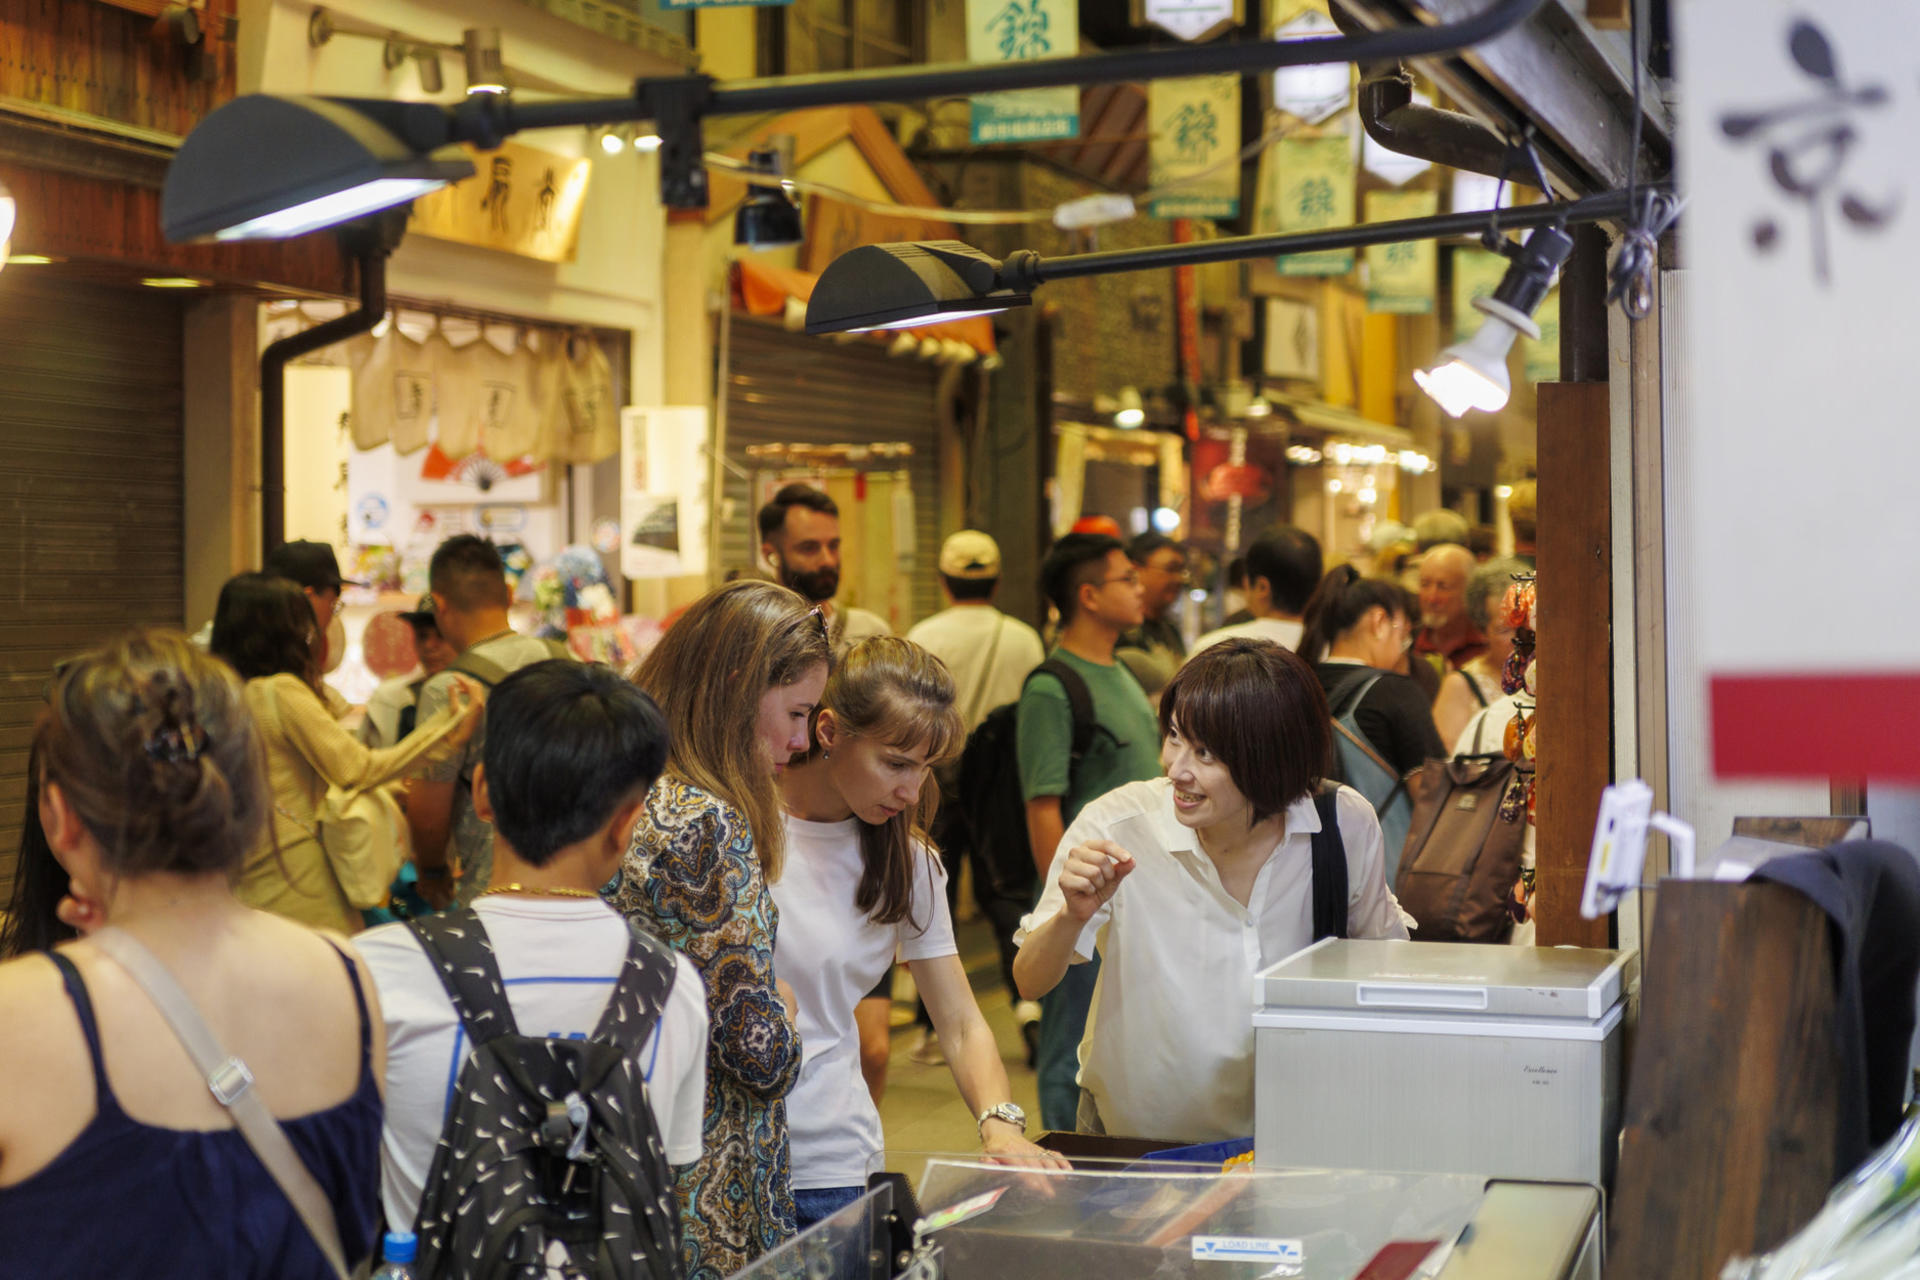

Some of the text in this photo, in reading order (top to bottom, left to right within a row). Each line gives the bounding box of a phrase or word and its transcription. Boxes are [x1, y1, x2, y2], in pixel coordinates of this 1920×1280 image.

[1715, 17, 1897, 288] 京
[1222, 1240, 1270, 1250] LOAD LINE
